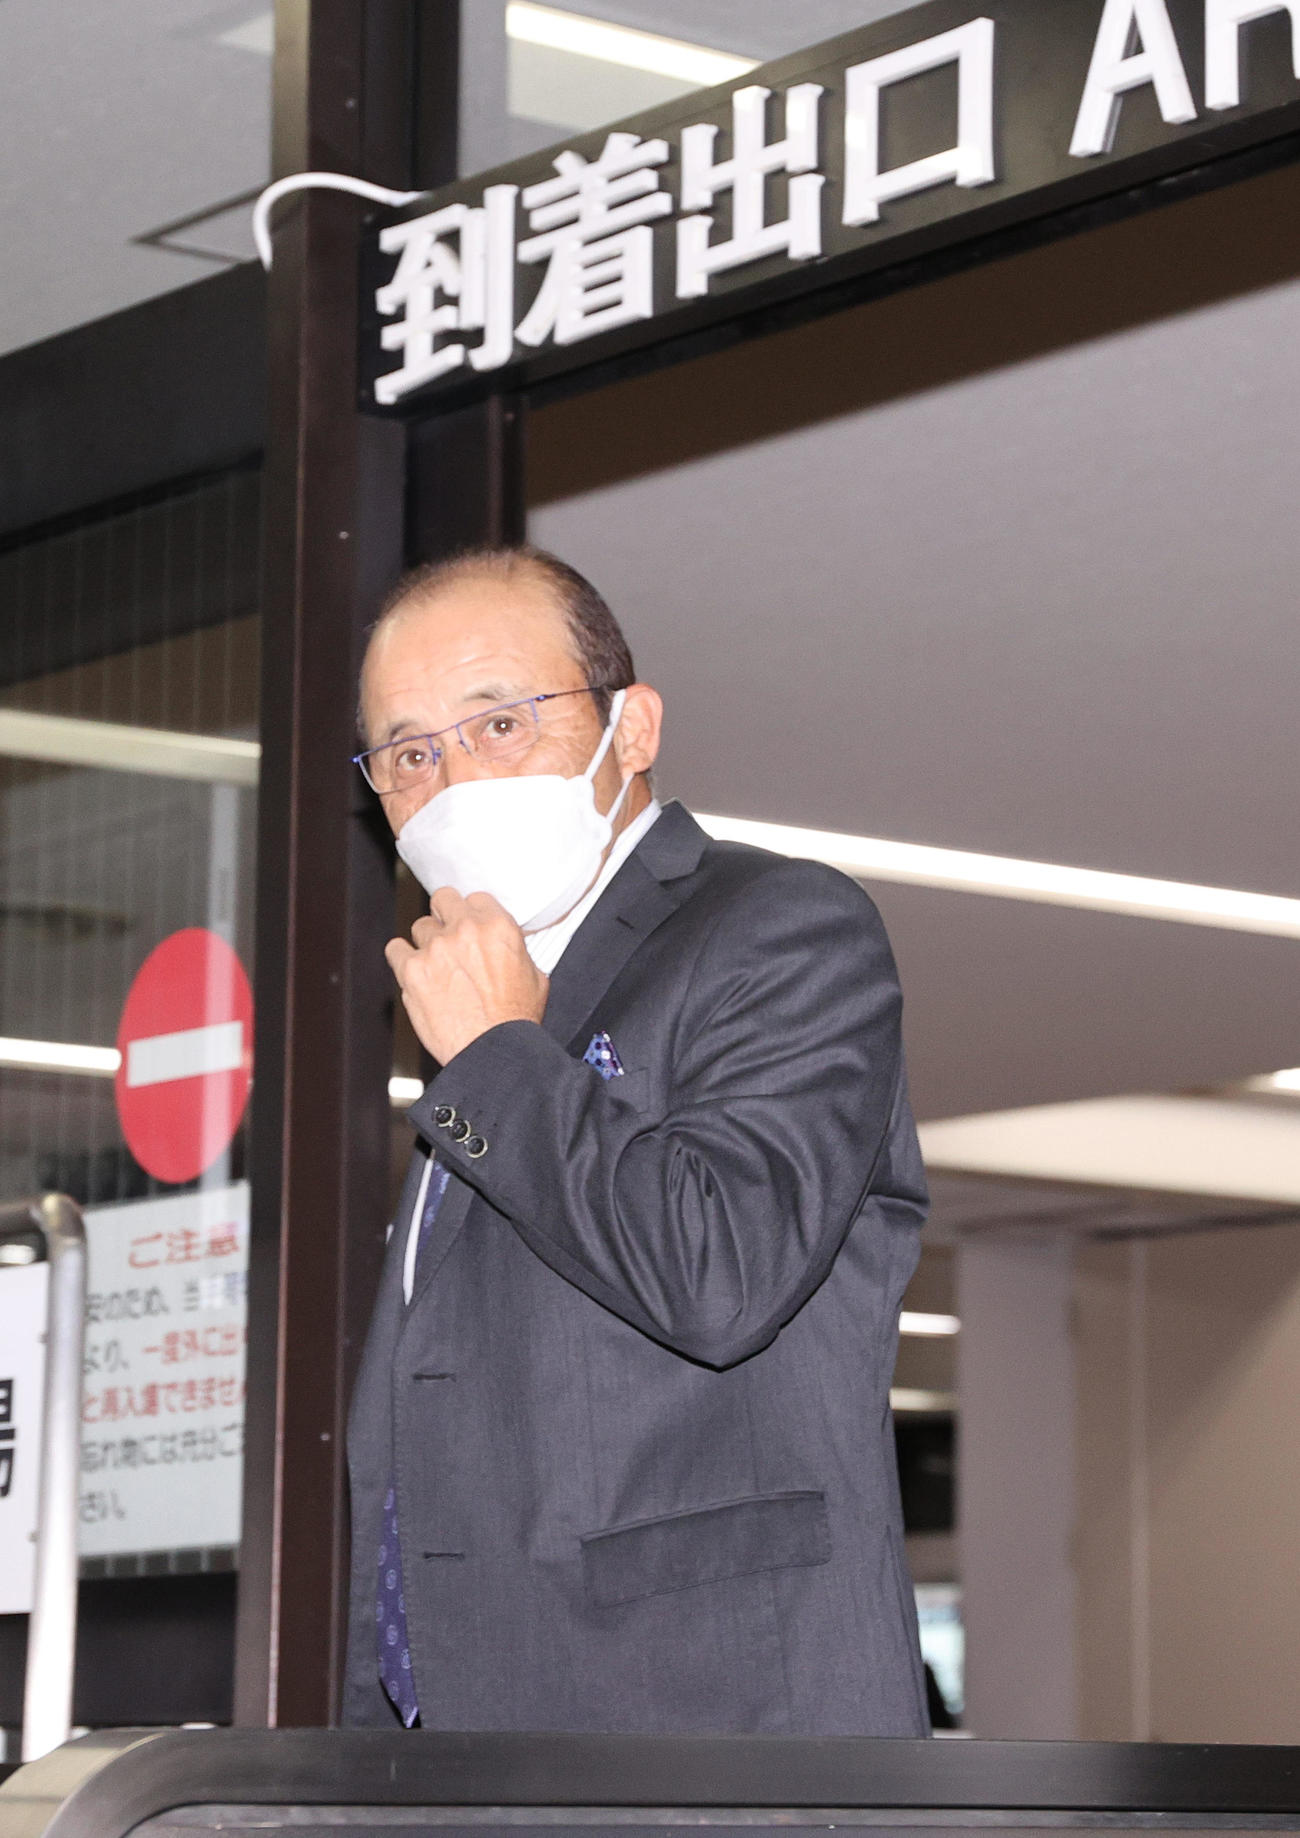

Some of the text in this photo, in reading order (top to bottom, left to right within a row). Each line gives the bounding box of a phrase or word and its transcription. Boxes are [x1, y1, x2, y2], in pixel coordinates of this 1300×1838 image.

[375, 17, 996, 405] 到着出口
[128, 1221, 239, 1269] ご注意
